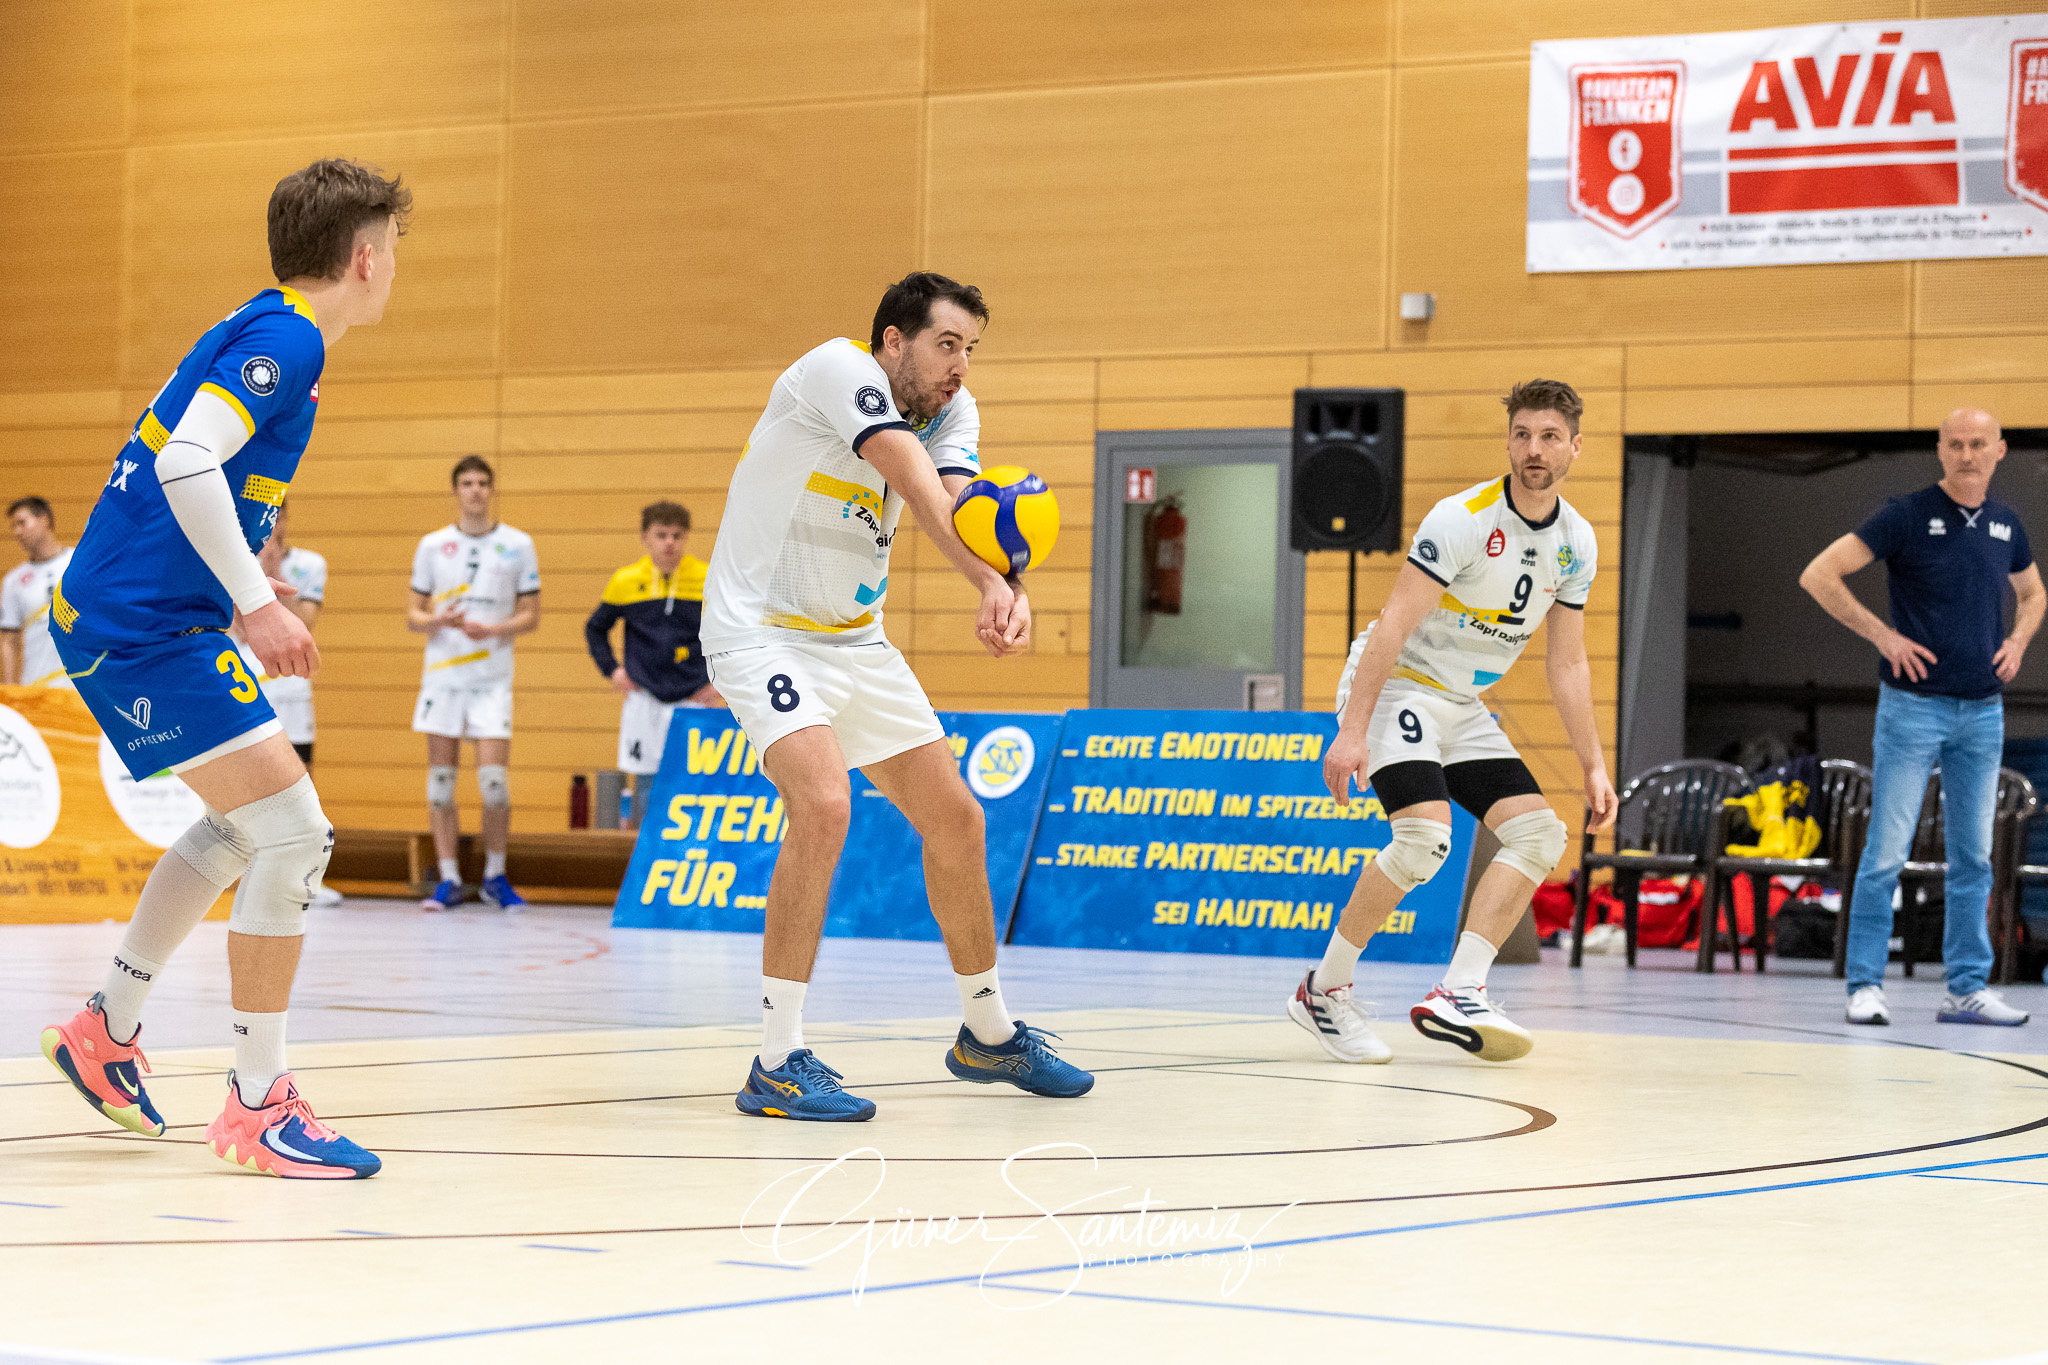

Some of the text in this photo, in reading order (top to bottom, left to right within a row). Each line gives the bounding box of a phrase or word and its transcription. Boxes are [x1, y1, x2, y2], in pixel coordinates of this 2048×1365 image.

[1509, 574, 1534, 613] 9
[1469, 617, 1498, 637] Zapf
[216, 650, 258, 703] 3
[767, 674, 801, 712] 8
[1398, 709, 1423, 744] 9
[1085, 734, 1156, 759] ECHTE
[1159, 731, 1324, 762] EMOTIONEN
[1072, 785, 1217, 817] TRADITION
[1220, 794, 1252, 817] IM
[1056, 843, 1141, 869] STARKE
[1153, 901, 1190, 925] SEI
[1195, 898, 1334, 931] HAUTNAH
